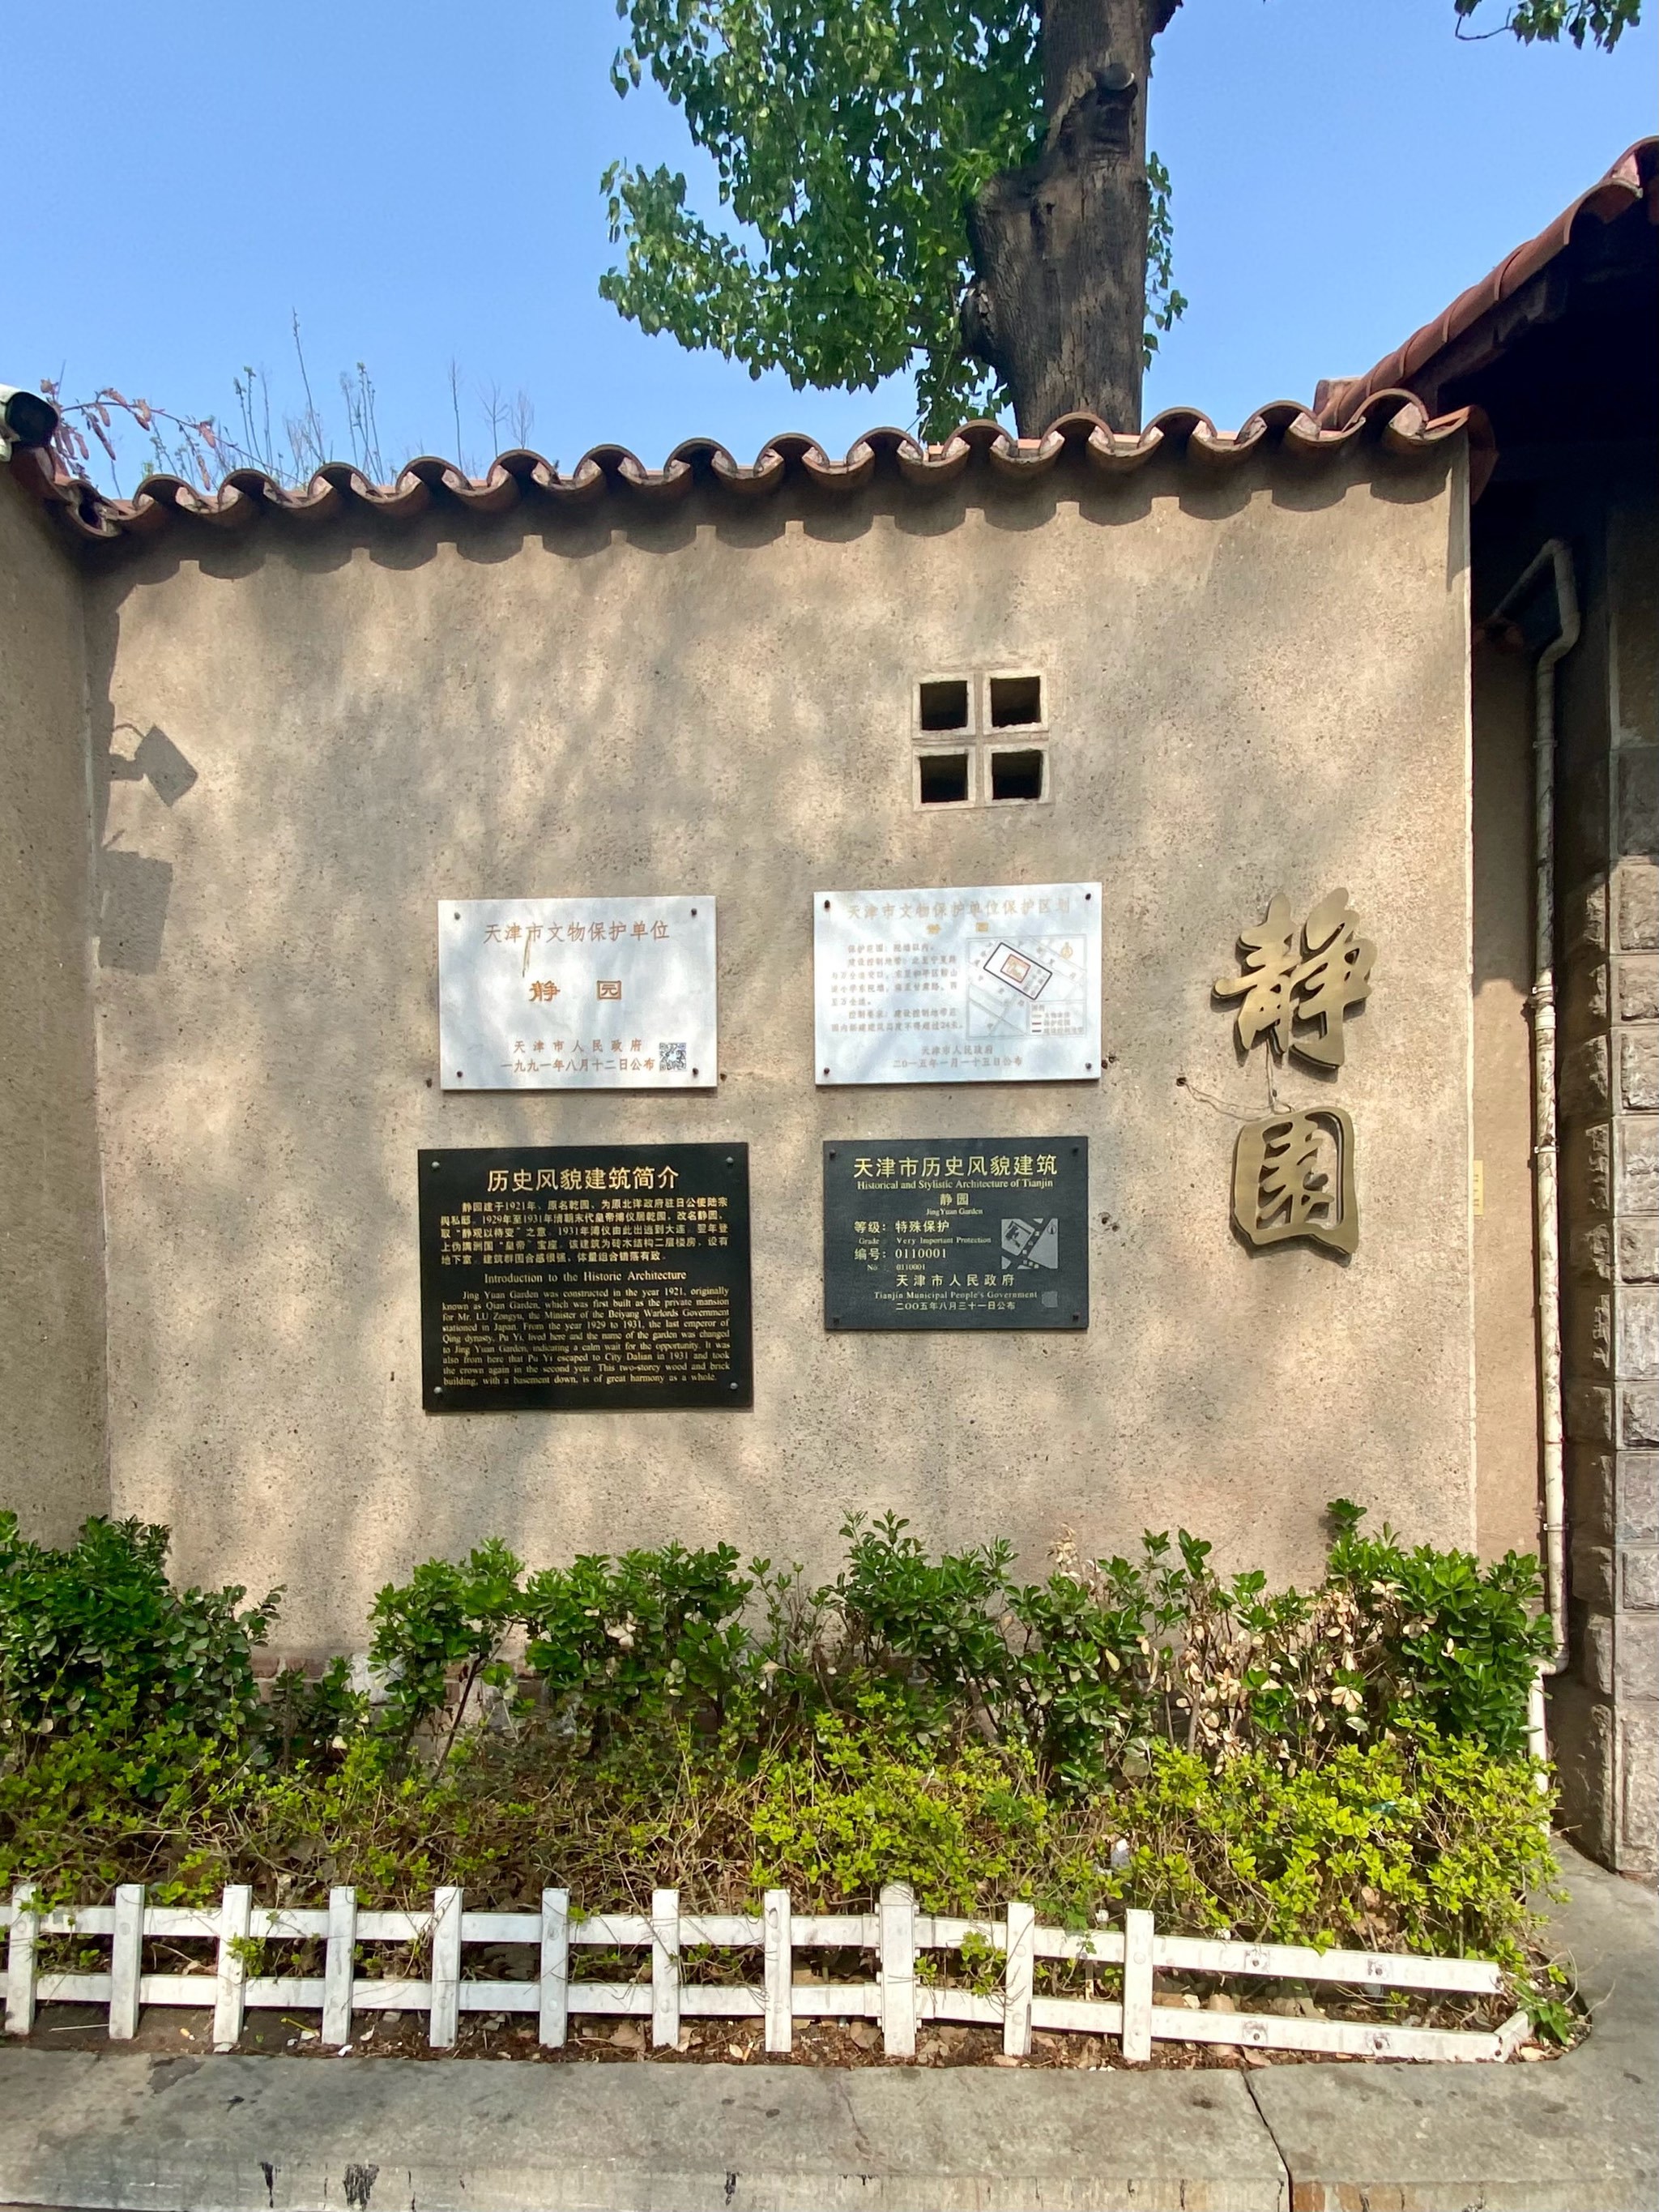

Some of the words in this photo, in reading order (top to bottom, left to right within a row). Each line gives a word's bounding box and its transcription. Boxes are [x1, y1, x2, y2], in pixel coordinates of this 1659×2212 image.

[483, 920, 670, 943] 天津市文物保护单位
[528, 980, 621, 1001] 静园
[513, 1040, 642, 1053] 天津市人民政府
[501, 1057, 655, 1072] 一九九一年八月十二日公布
[854, 1154, 1057, 1178] 天津市历史风貌建筑
[487, 1166, 679, 1193] 历史风貌建筑简介
[857, 1181, 898, 1189] Historical
[901, 1181, 916, 1189] and
[919, 1180, 953, 1189] Stylistic
[955, 1180, 1009, 1188] Architecture
[1010, 1179, 1020, 1187] of
[1021, 1178, 1053, 1189] Tianjin
[940, 1193, 968, 1206] 静园
[895, 1219, 949, 1232] 特殊保护
[895, 1249, 946, 1258] 0110001
[484, 1274, 543, 1283] Introduction
[548, 1274, 557, 1282] to
[564, 1273, 578, 1282] the
[583, 1272, 621, 1281] Historic
[627, 1271, 687, 1280] Architecture
[896, 1274, 1015, 1287] 天津市人民政府
[463, 1292, 480, 1300] Jing
[510, 1290, 539, 1298] Garden
[564, 1289, 608, 1298] constructed
[642, 1289, 659, 1297] year
[690, 1287, 729, 1296] originally
[987, 1291, 1037, 1299] Government
[486, 1302, 505, 1310] Qian
[613, 1299, 631, 1307] built
[664, 1299, 692, 1308] private
[696, 1297, 729, 1305] mansion
[608, 1310, 639, 1319] Beiyang
[442, 1323, 477, 1331] stationed
[684, 1320, 716, 1328] emperor
[442, 1334, 461, 1343] Qing
[652, 1330, 677, 1340] garden
[699, 1330, 730, 1339] changed
[454, 1346, 470, 1356] Jing
[533, 1344, 569, 1353] indicating
[557, 1354, 588, 1363] escaped
[605, 1353, 621, 1362] City
[627, 1352, 652, 1360] Dalian
[488, 1367, 510, 1375] again
[620, 1364, 660, 1373] two-storey
[606, 1375, 626, 1384] great
[630, 1373, 664, 1384] harmony
